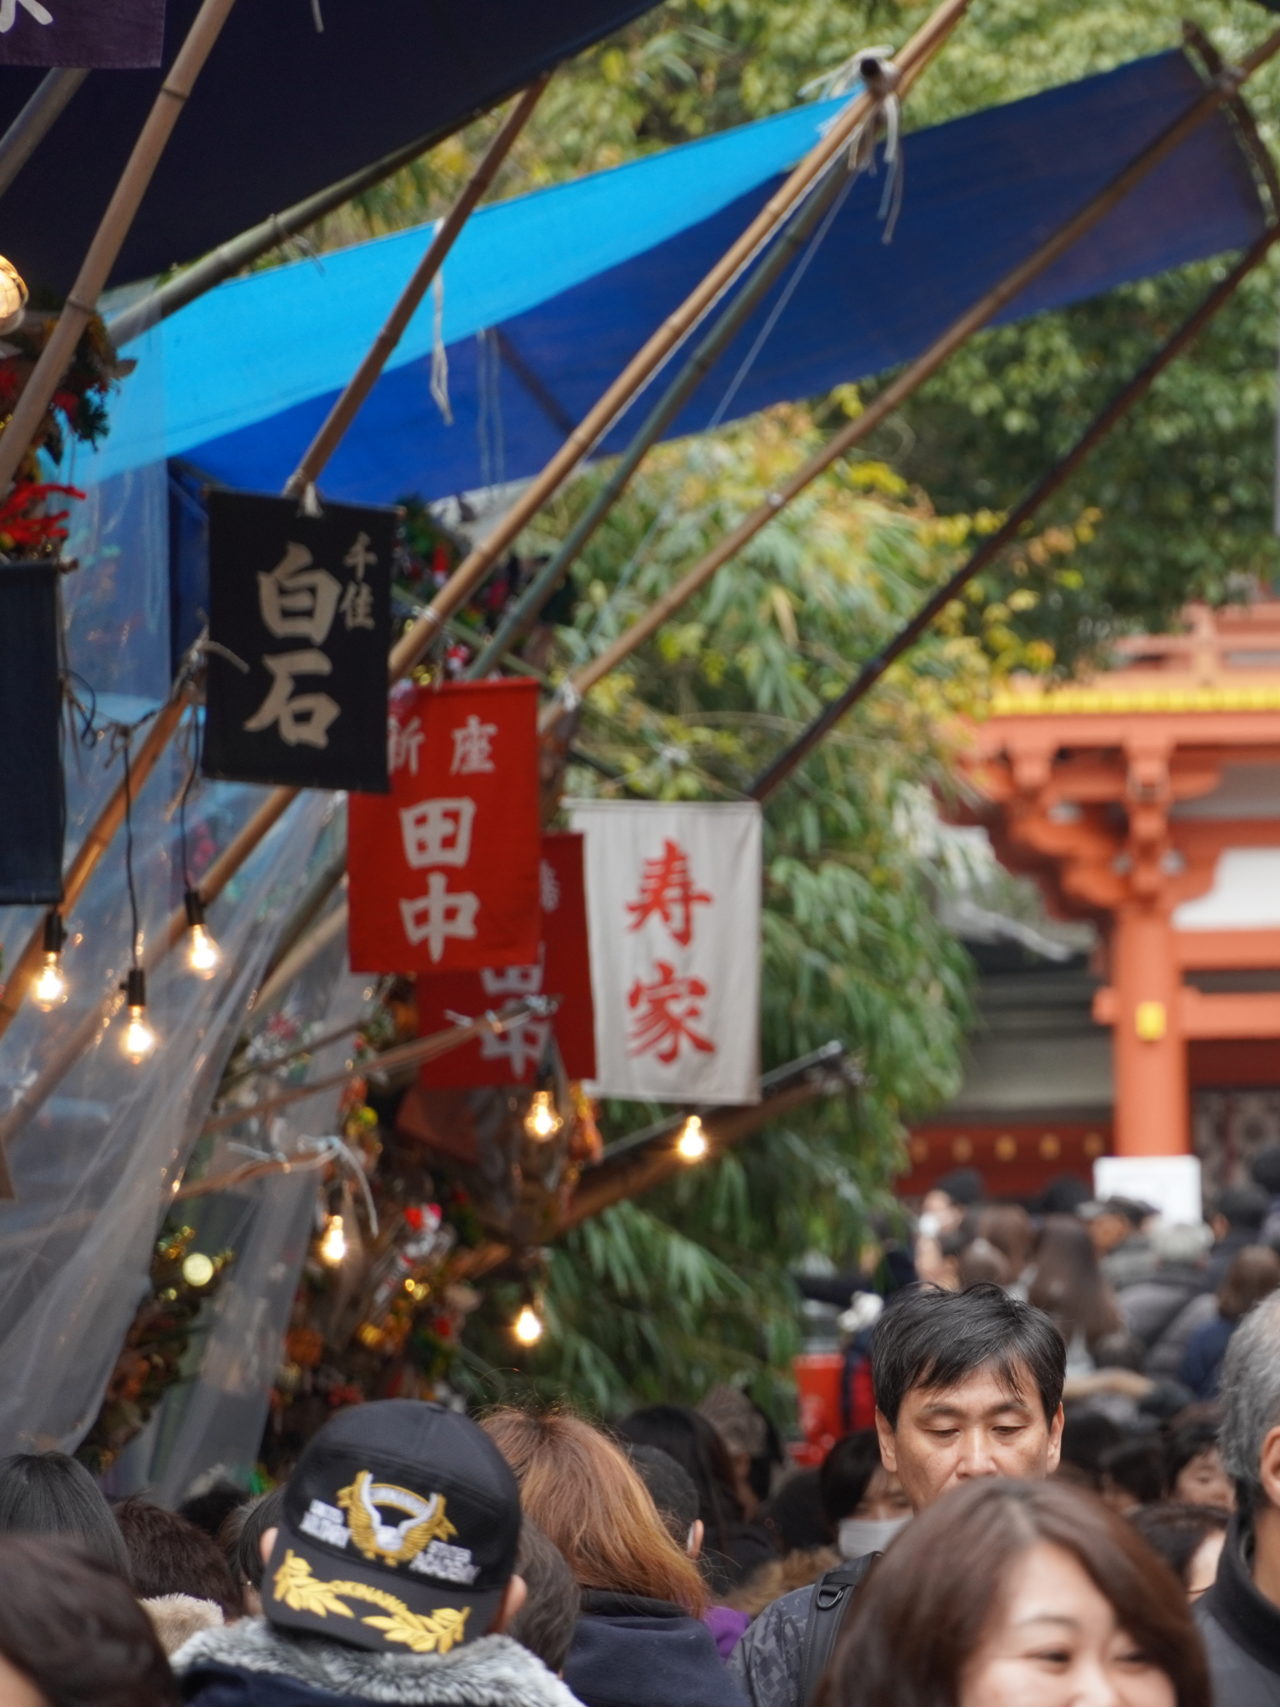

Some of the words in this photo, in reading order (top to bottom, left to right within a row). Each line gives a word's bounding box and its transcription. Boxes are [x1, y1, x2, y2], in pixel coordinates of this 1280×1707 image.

[243, 540, 341, 750] 白石
[400, 797, 480, 964] 田中
[625, 838, 716, 1065] 寿家
